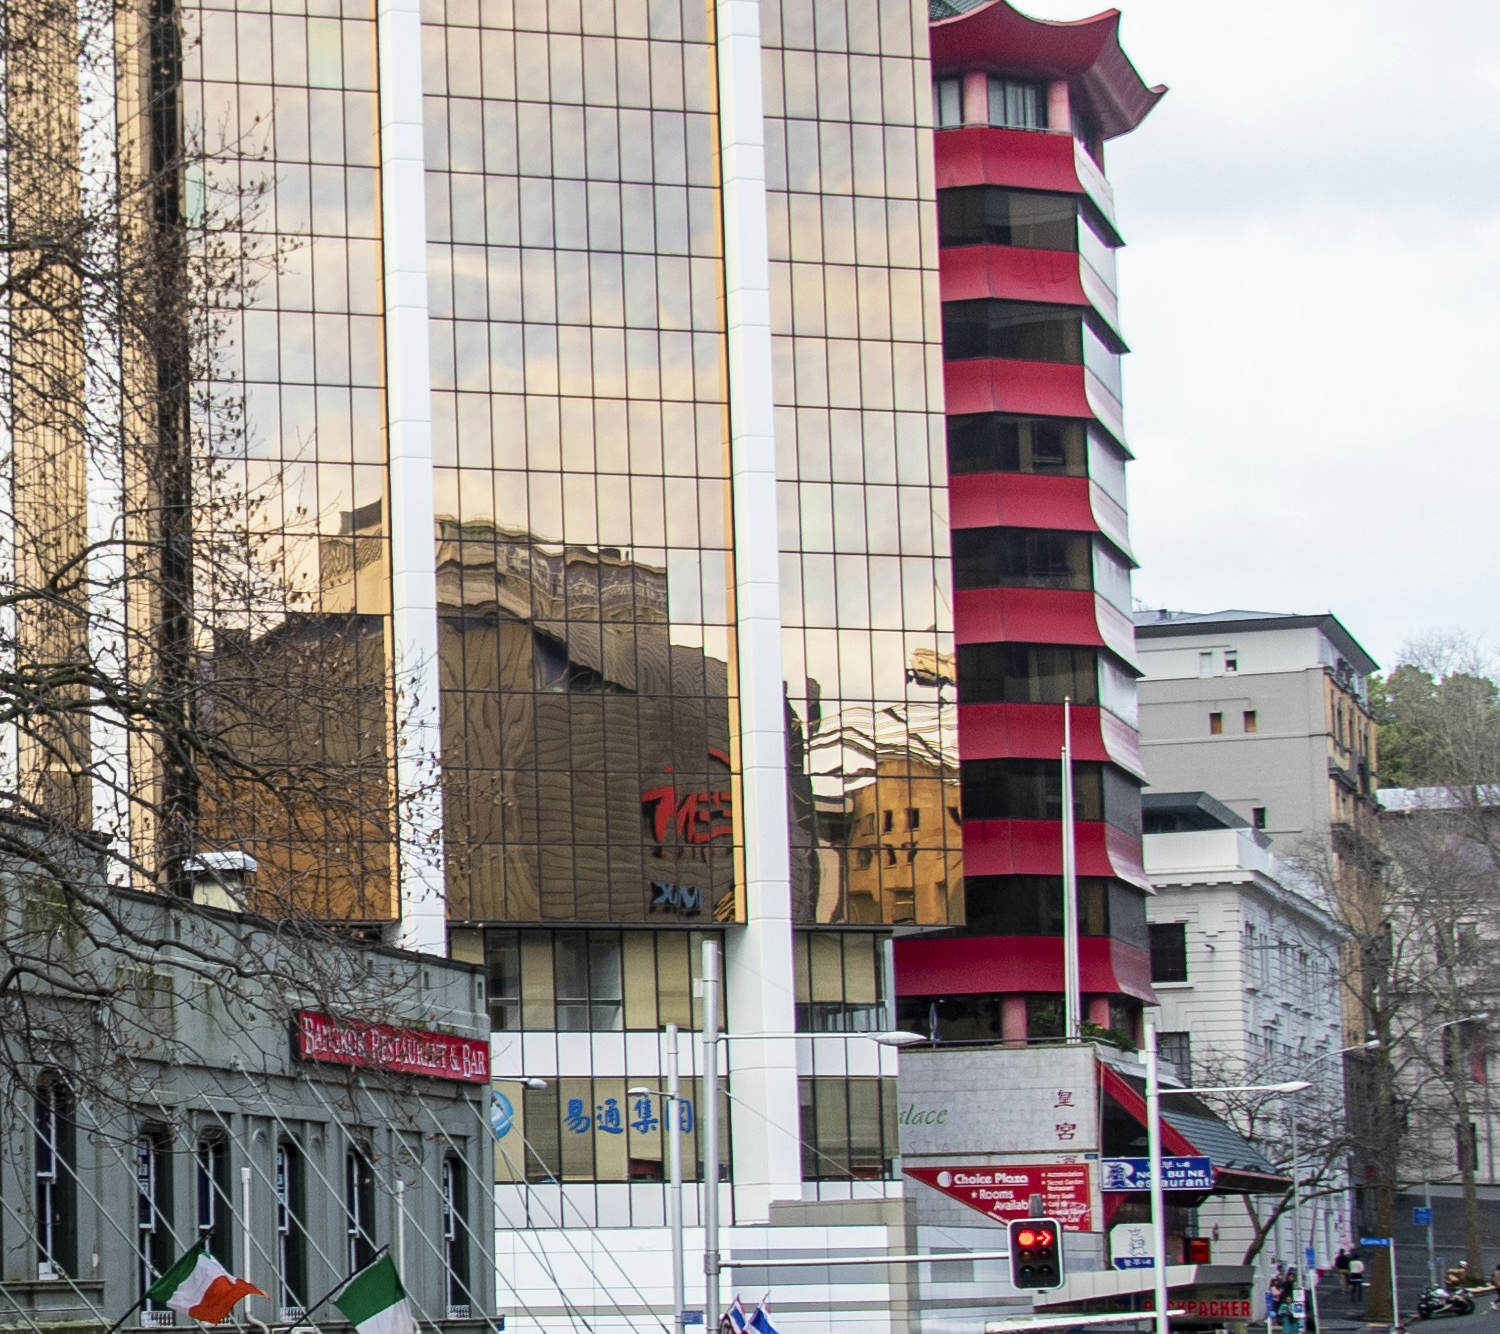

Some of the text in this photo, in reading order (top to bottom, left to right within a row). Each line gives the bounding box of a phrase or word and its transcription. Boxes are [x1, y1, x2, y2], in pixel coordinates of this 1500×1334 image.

[450, 1045, 460, 1072] &
[462, 1044, 486, 1078] BAR
[953, 1173, 1029, 1185] Choice Plaza
[1167, 1170, 1185, 1178] BU
[979, 1189, 1014, 1200] Rooms
[993, 1200, 1030, 1211] Availab
[1144, 1299, 1251, 1317] BCKPACKER
